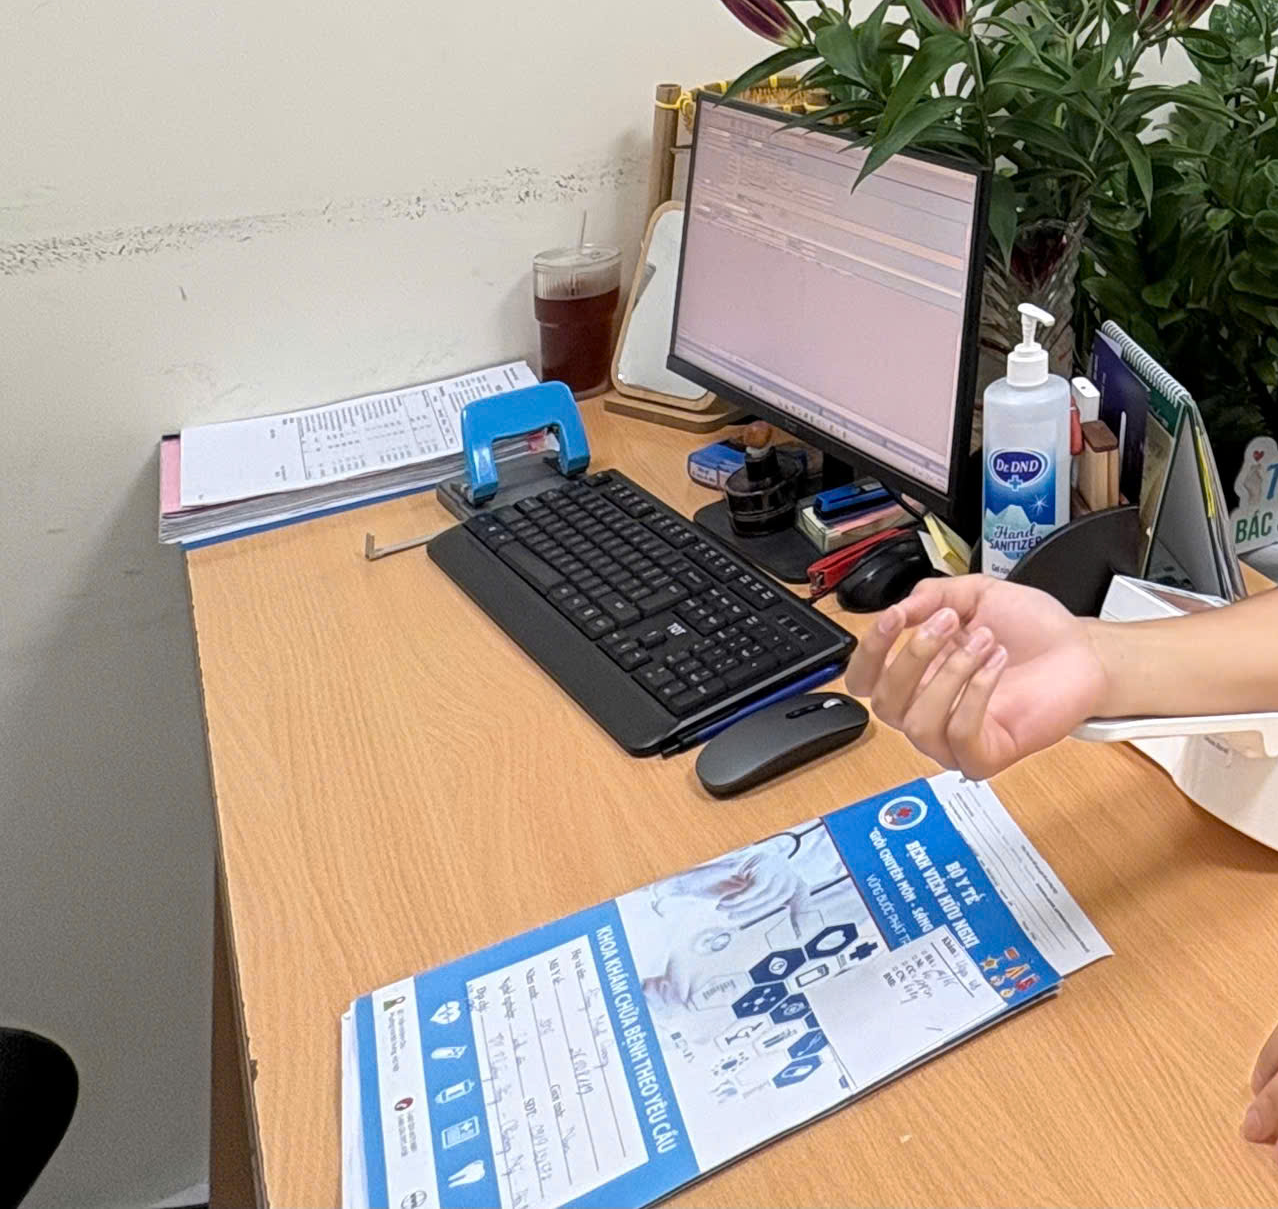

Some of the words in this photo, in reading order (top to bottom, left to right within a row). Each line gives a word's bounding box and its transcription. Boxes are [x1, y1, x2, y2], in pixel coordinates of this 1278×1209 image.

[994, 523, 1036, 540] Hand
[1235, 510, 1273, 544] BÁC
[880, 848, 905, 882] CHUYÊN
[905, 840, 933, 871] BỆNH
[922, 866, 949, 897] VIỆN
[945, 861, 967, 880] BỘ
[955, 876, 971, 888] Y
[961, 886, 986, 906] TẾ
[595, 924, 619, 961] KHOA
[604, 957, 629, 996] KHÁM
[614, 993, 640, 1029] CHỮA
[621, 1024, 649, 1063] BỆNH
[633, 1058, 660, 1097] THEO
[644, 1092, 668, 1125] YÊU
[652, 1122, 679, 1154] CẦU
